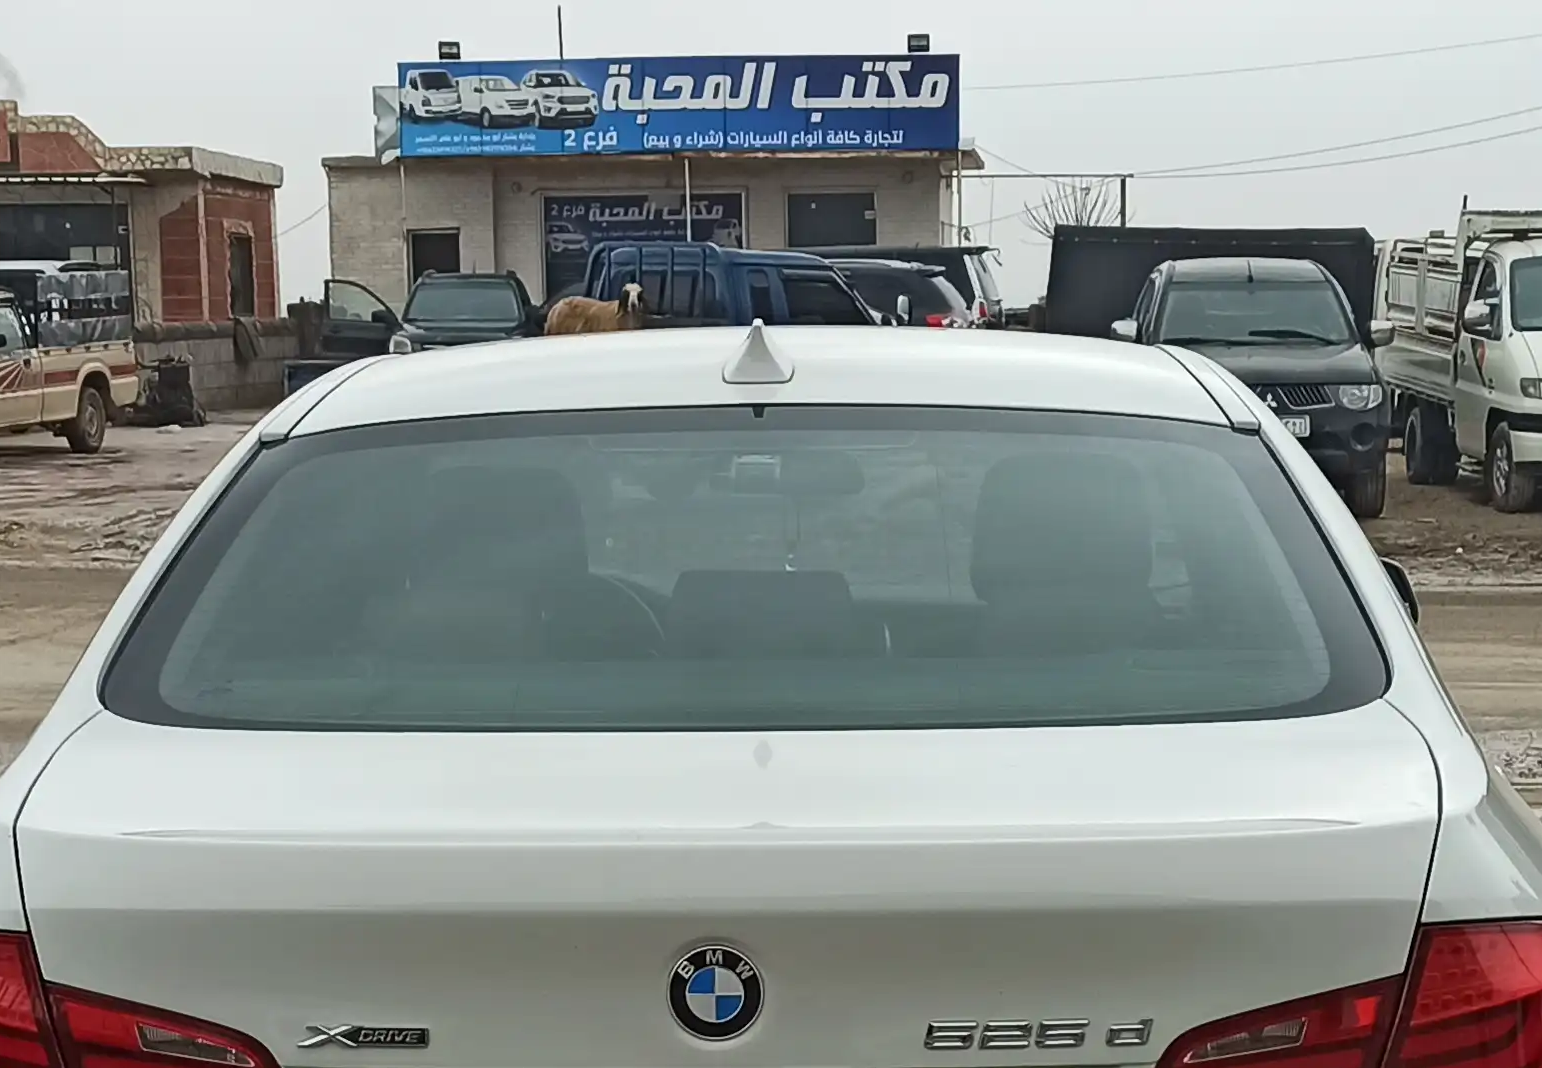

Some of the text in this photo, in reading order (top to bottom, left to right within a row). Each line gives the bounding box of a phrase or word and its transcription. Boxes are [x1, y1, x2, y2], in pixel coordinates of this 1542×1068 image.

[602, 61, 951, 125] مكتب المحبة
[563, 127, 617, 151] فرع 2
[728, 130, 787, 148] السيارات
[827, 130, 860, 146] كافة
[864, 130, 904, 148] لتجارة
[551, 204, 559, 216] 2
[563, 204, 585, 219] فرع
[588, 201, 657, 227] المحبة
[676, 949, 754, 980] BMW
[923, 1018, 1090, 1049] 525
